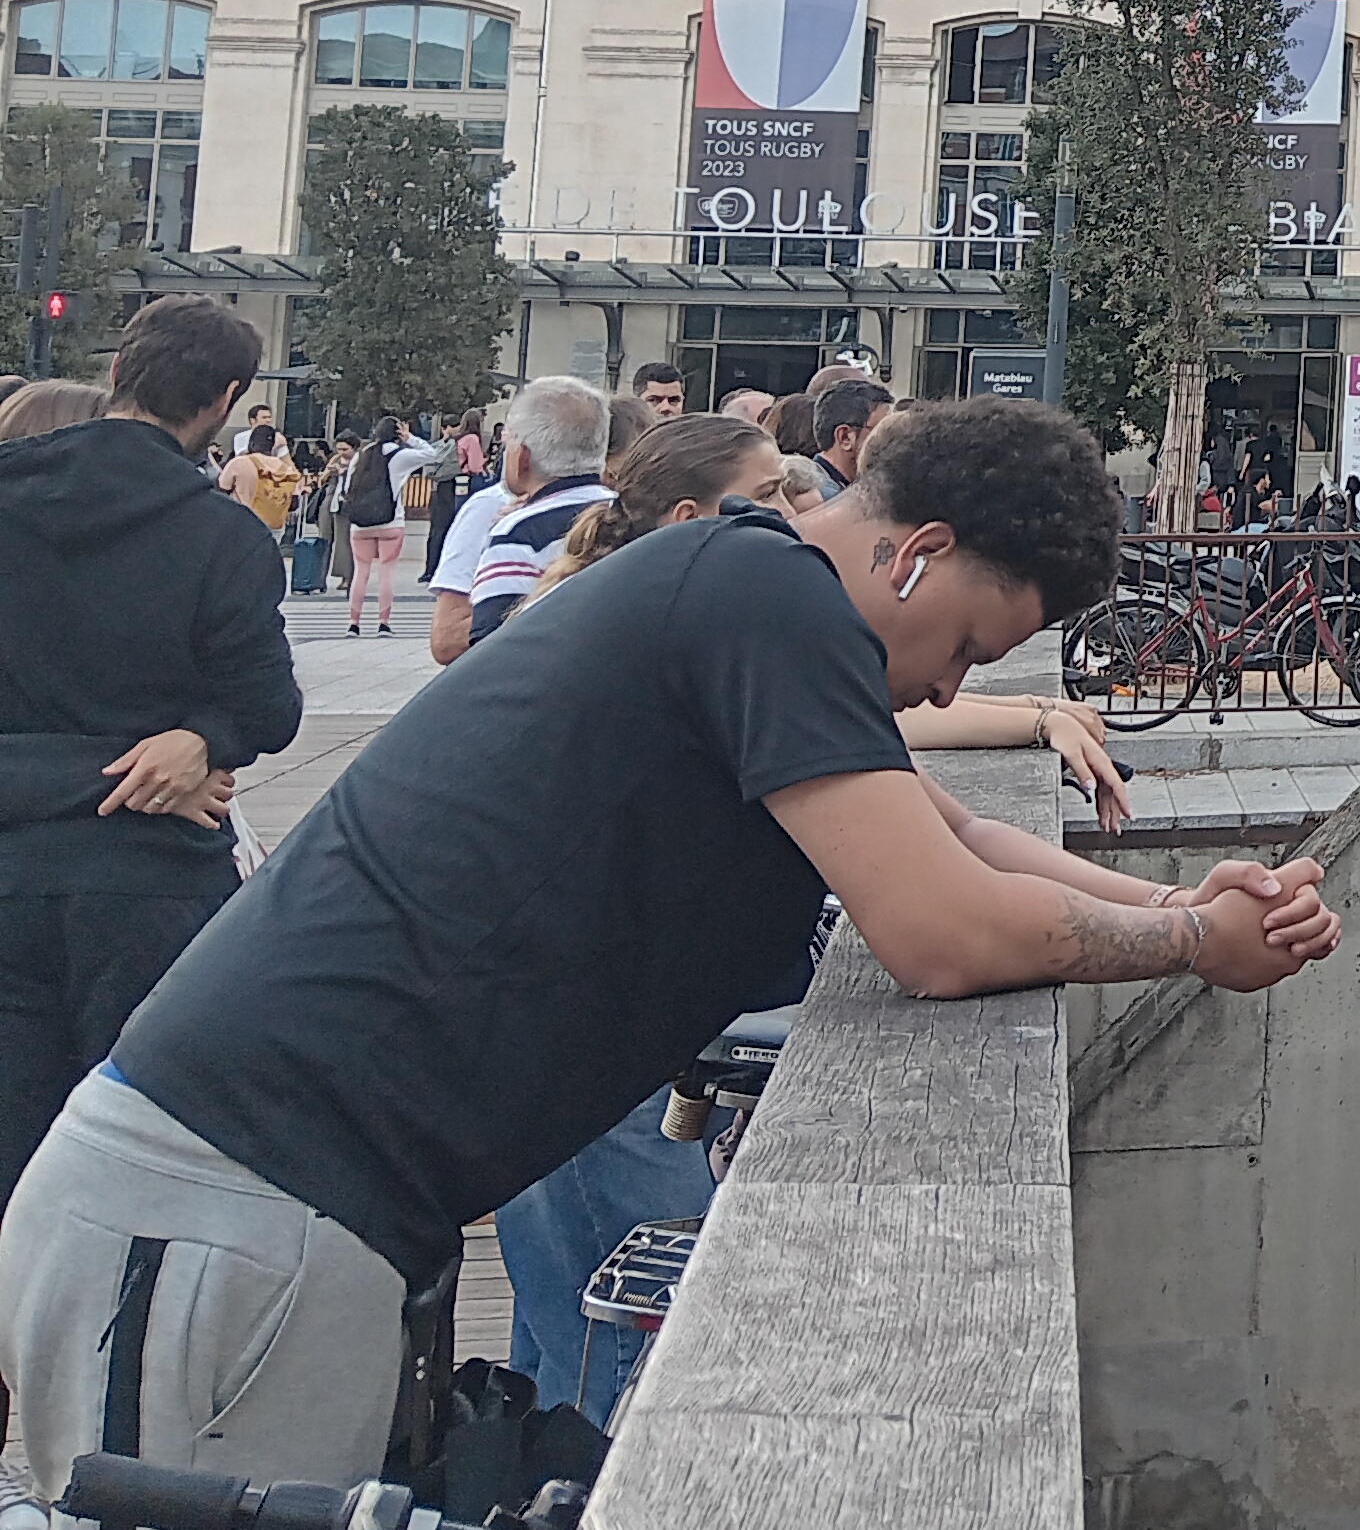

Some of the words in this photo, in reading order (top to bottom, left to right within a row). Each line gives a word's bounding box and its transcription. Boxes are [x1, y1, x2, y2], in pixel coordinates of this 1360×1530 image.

[704, 119, 758, 137] TOUS
[762, 121, 816, 138] SNCF
[703, 139, 755, 157] TOUS
[760, 141, 825, 159] RUGBY
[701, 160, 746, 177] 2023
[663, 186, 1042, 237] TOULOUSE
[983, 372, 1034, 383] Matabiau
[992, 382, 1024, 394] Gares
